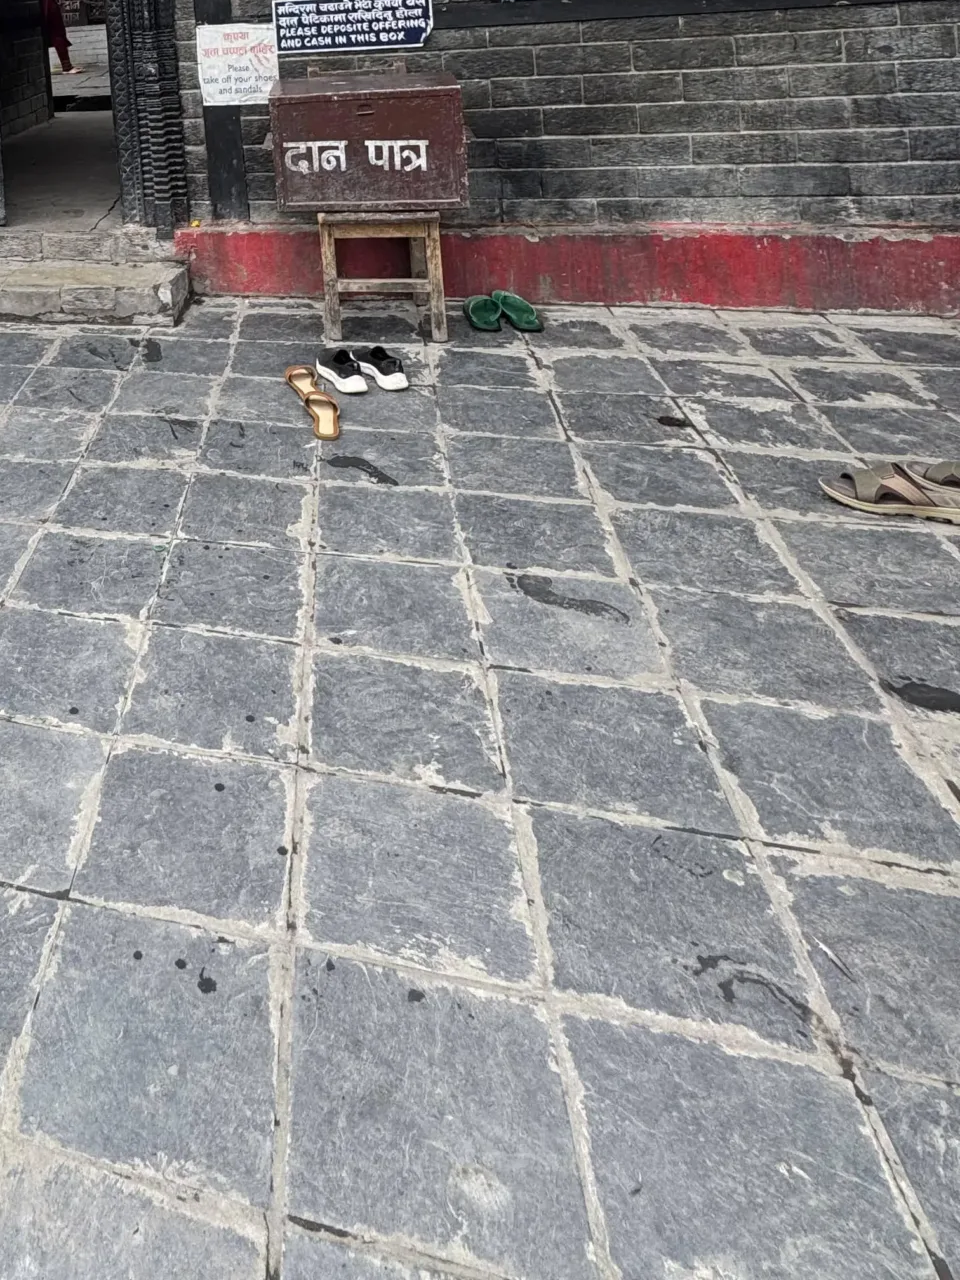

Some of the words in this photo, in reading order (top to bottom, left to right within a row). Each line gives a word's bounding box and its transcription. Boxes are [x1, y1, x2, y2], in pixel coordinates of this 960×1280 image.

[276, 2, 317, 14] मन्दिरमा
[280, 27, 318, 37] PLEASE
[321, 23, 369, 33] DEPOSITE
[372, 19, 425, 30] OFFERING
[280, 38, 301, 48] AND
[304, 37, 331, 46] CASH
[335, 36, 346, 44] IN
[350, 33, 376, 43] THIS
[380, 32, 406, 42] BOX
[228, 64, 250, 72] Please
[203, 76, 219, 84] take
[222, 75, 232, 83] off
[234, 76, 252, 85] your
[218, 86, 232, 95] and
[235, 84, 262, 94] sandals
[283, 140, 348, 174] दान
[364, 139, 429, 172] पात्र
